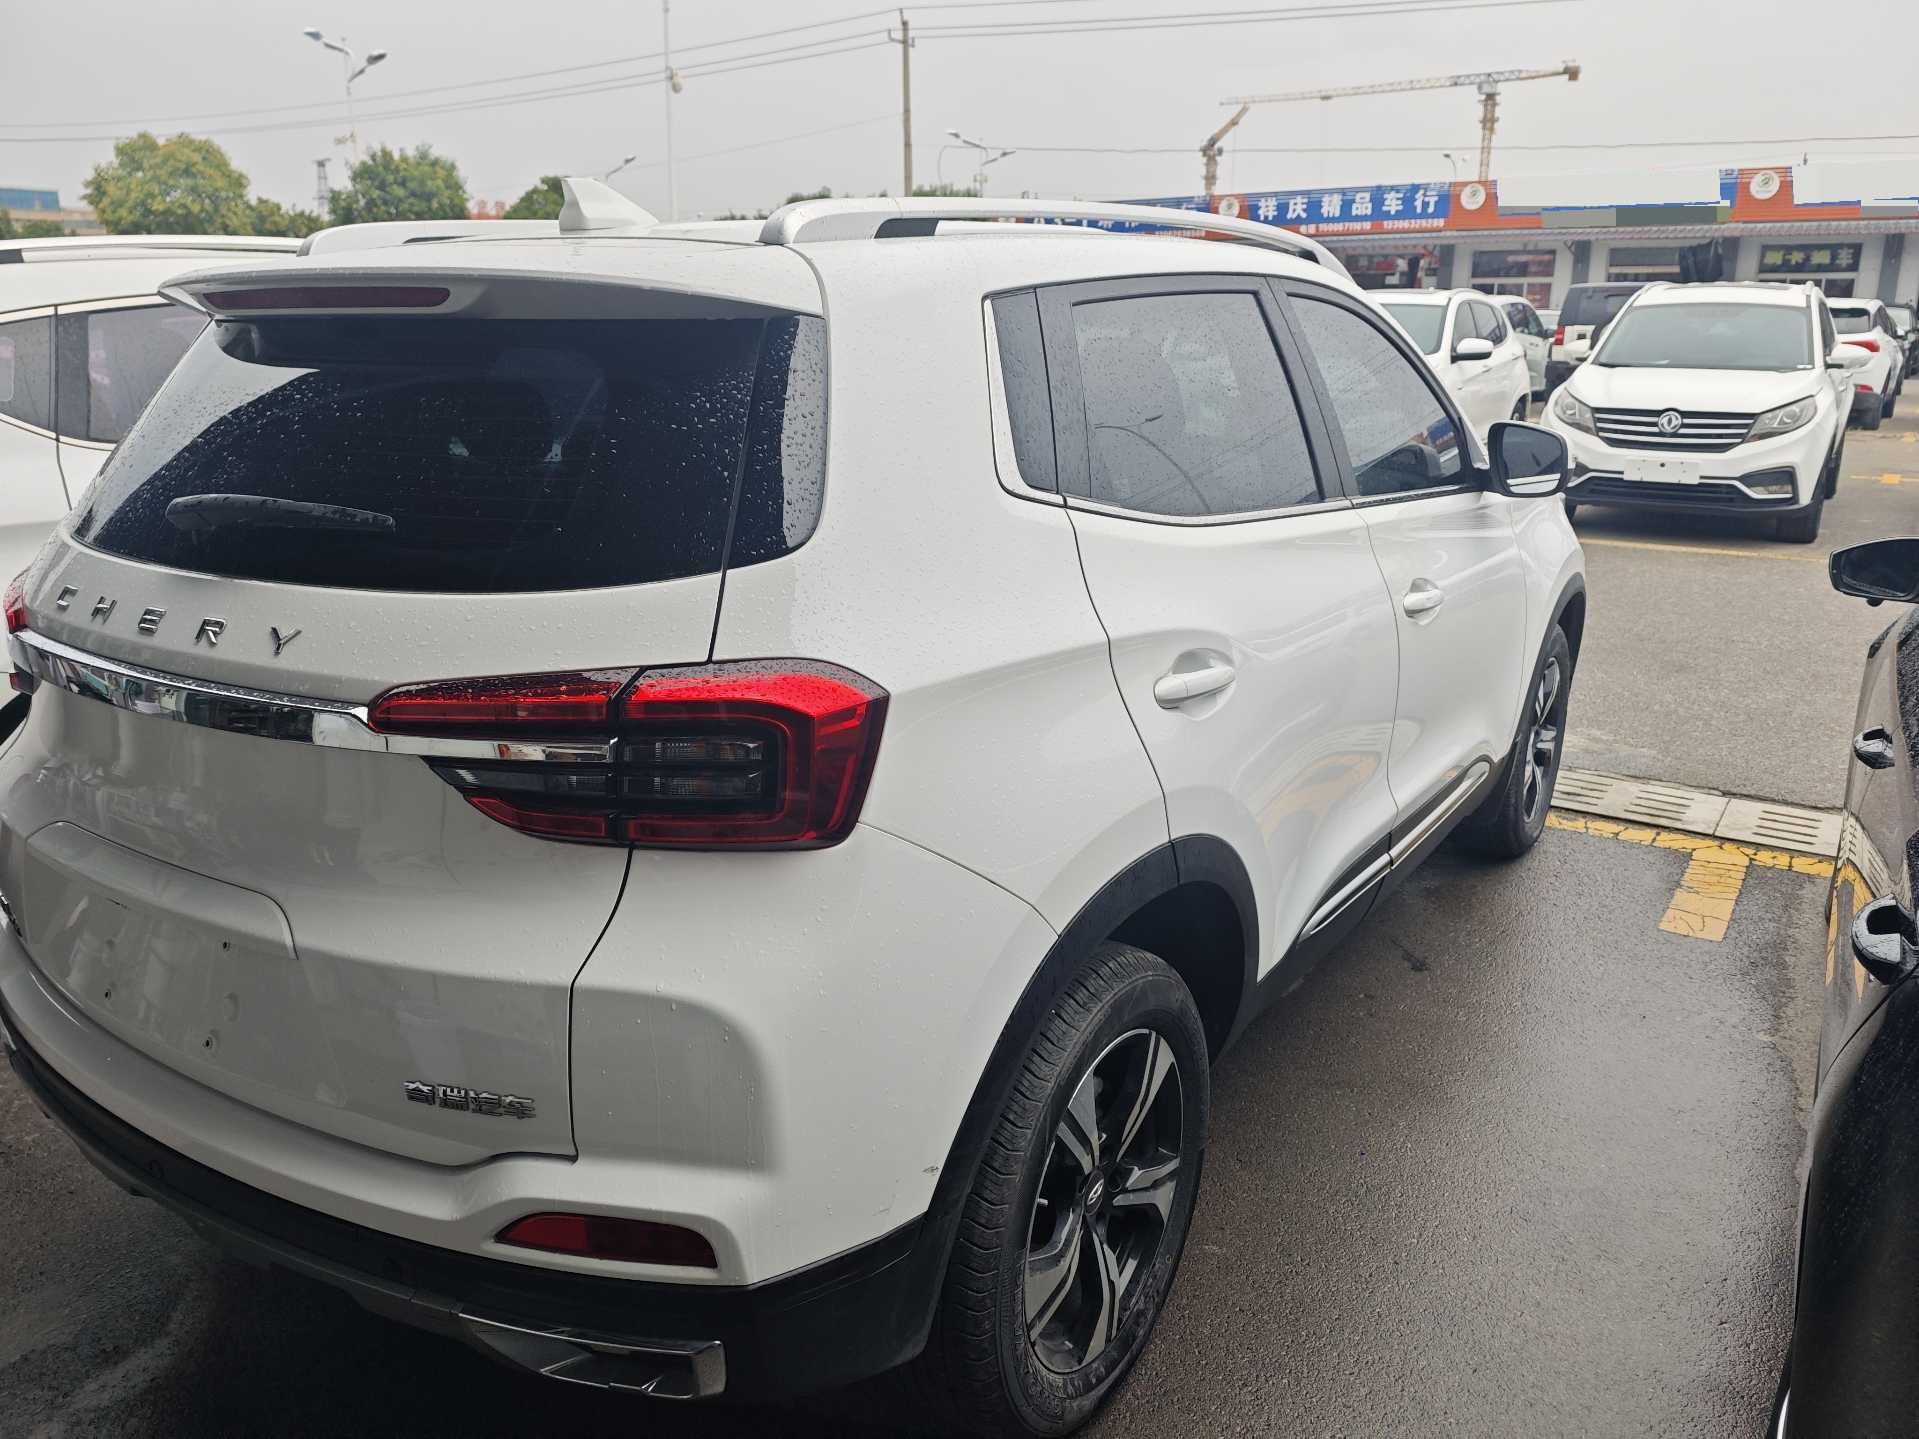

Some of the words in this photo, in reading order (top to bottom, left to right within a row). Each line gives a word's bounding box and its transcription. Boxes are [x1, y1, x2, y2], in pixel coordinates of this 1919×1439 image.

[56, 584, 301, 656] CHERY
[402, 1080, 536, 1119] 奇瑞汽车
